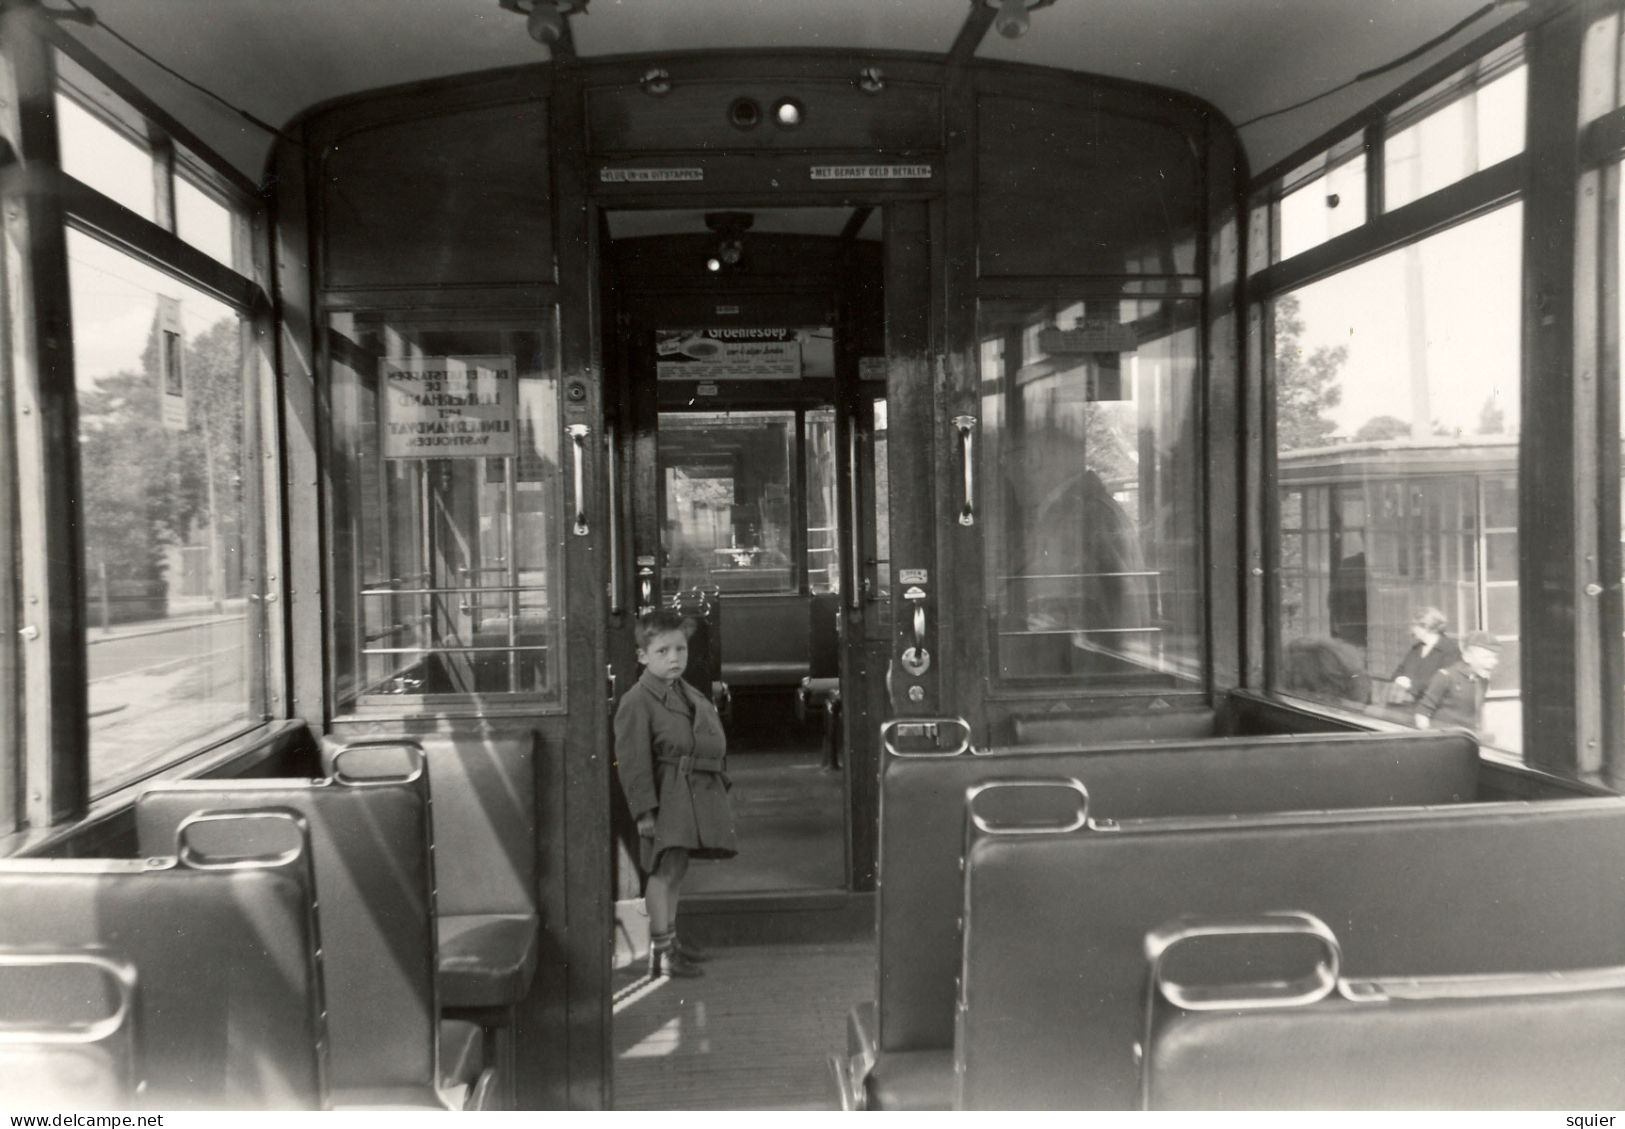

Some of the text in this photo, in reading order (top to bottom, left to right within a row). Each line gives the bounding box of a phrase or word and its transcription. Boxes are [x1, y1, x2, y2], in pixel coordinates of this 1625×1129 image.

[815, 167, 928, 177] MET GEPAST GELD BETALEN
